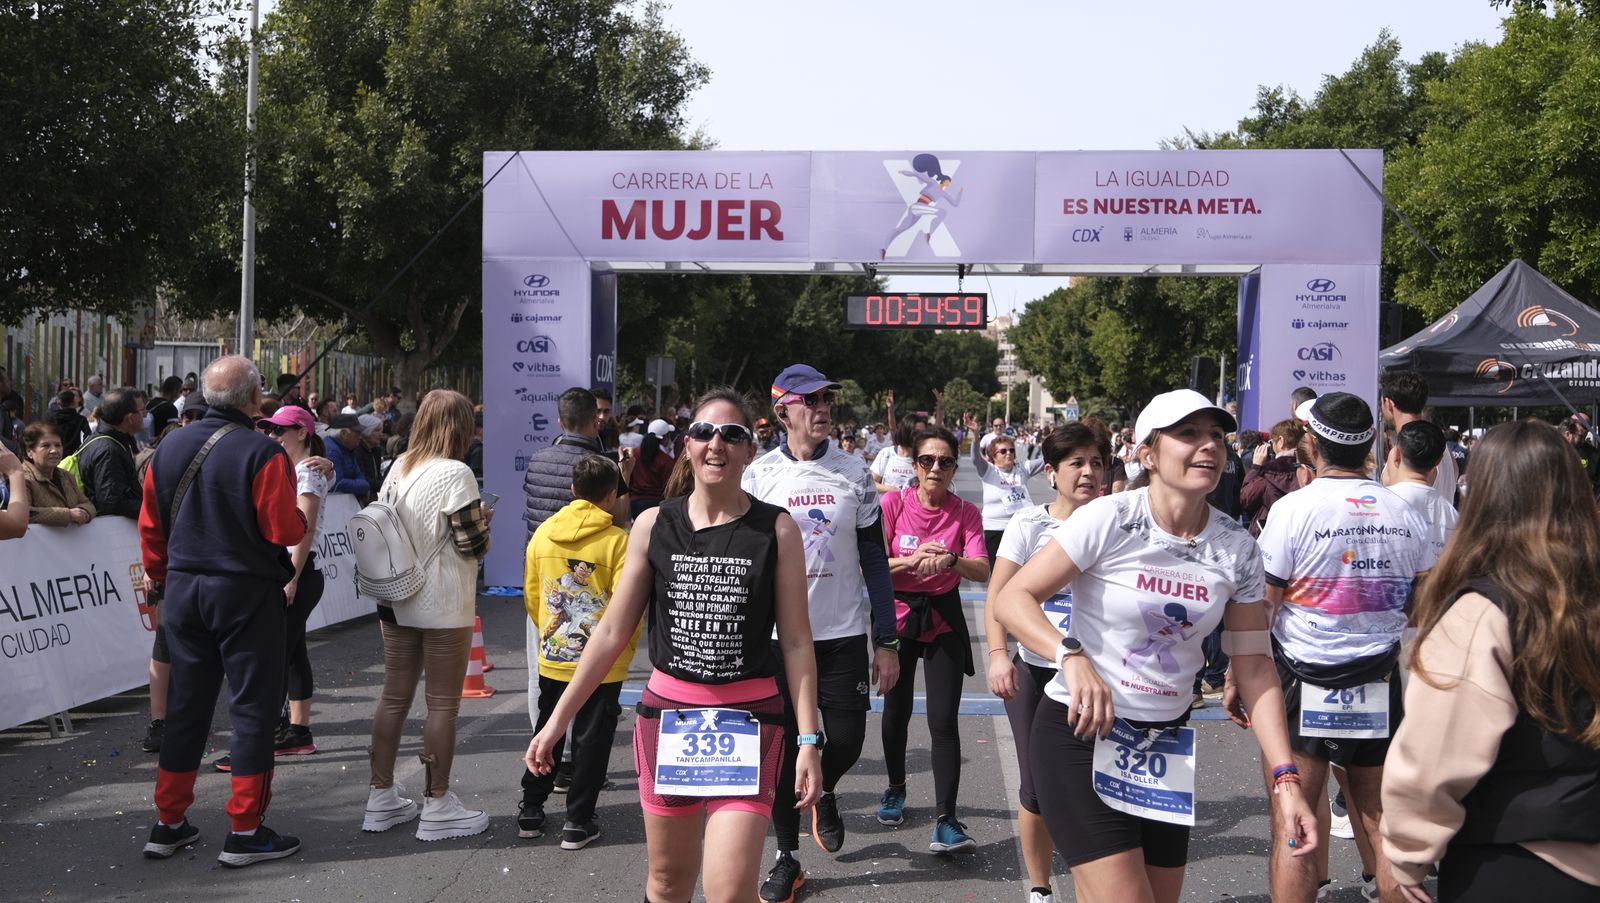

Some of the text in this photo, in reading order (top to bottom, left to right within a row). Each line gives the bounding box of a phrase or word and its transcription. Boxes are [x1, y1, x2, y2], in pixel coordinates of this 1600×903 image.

[612, 172, 774, 190] CARRERA DE LA
[1095, 170, 1230, 188] LA IGUALDAD
[1063, 198, 1262, 215] ES NUESTRA META.
[601, 199, 784, 241] MUJER
[1072, 226, 1104, 242] CDX
[1140, 227, 1178, 235] ALMERÍA
[1295, 294, 1346, 302] HYUNDAI
[866, 296, 981, 325] 00:34:59
[525, 313, 562, 323] cajamar
[1308, 319, 1349, 330] cajamar
[527, 362, 560, 372] vithas
[1520, 360, 1600, 379] cruzand
[1309, 370, 1346, 381] vithas
[524, 433, 549, 442] Clece
[788, 494, 836, 507] MUJER
[1007, 492, 1026, 502] 1324
[671, 554, 752, 566] SIEMPRE FUERTES
[1351, 558, 1391, 570] soltec
[673, 563, 747, 576] EMPEZAR DE CERO
[1143, 565, 1206, 583] CARRERA DE LA
[676, 573, 740, 585] UNA ESTRELLITA
[0, 564, 122, 622] ALMERÍA
[703, 584, 713, 592] EN
[713, 585, 749, 595] CAMPANILLA
[1136, 574, 1209, 602] MUJER
[667, 590, 748, 604] SUEÑA EN GRANDE
[675, 600, 738, 614] VOLAR SIN PENSARLO
[679, 610, 704, 619] SUEÑOS
[674, 617, 738, 633] CREE EN TI
[1, 623, 71, 658] CIUDAD
[701, 632, 717, 640] QUE
[1130, 682, 1162, 695] NUESTRA
[1323, 685, 1367, 704] 261
[1112, 727, 1135, 742] MUJER
[682, 733, 736, 756] 339
[1114, 745, 1167, 779] 320
[1120, 770, 1160, 786] ISA OLLER
